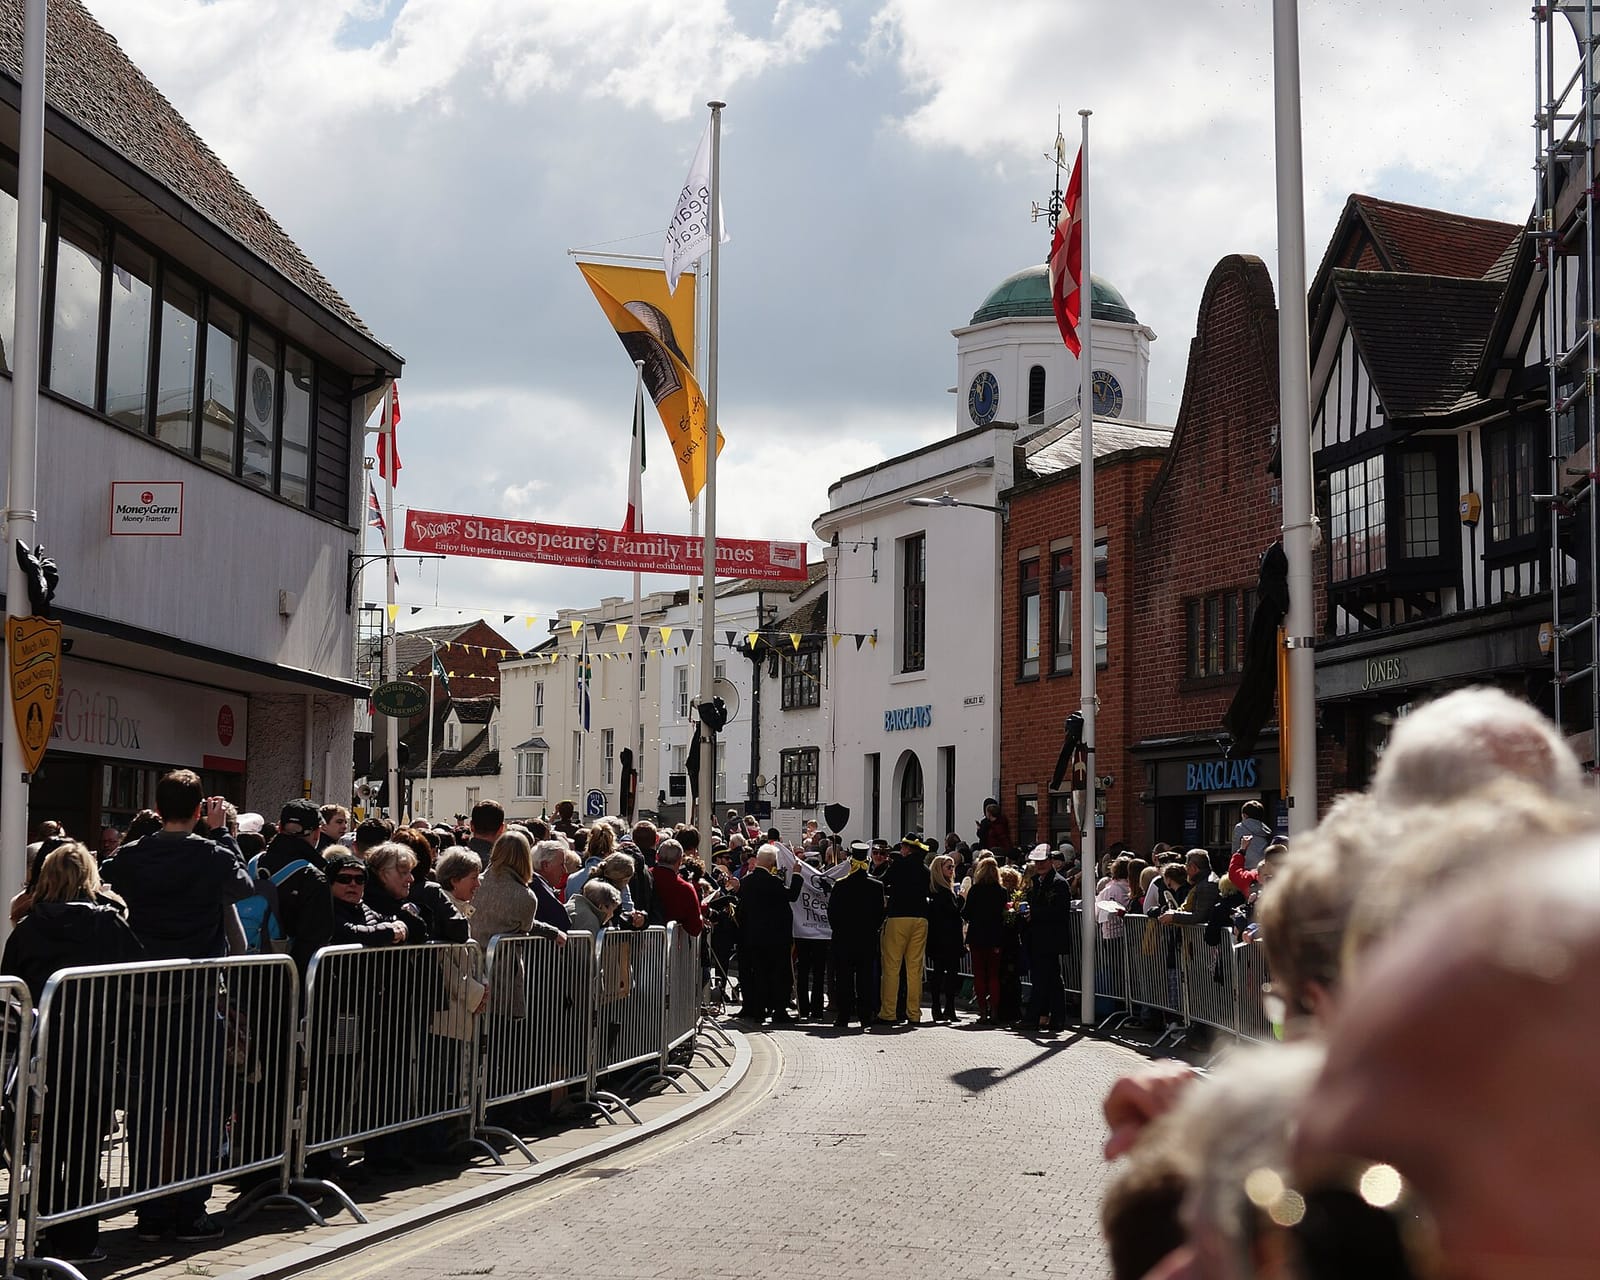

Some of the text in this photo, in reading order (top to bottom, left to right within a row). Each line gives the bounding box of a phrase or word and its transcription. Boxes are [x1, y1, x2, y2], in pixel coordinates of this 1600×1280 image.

[679, 440, 699, 465] 1564
[115, 504, 179, 516] MoneyGram
[121, 515, 144, 524] Money
[464, 520, 607, 552] Shakespeare's
[613, 536, 681, 562] Family
[686, 541, 754, 562] Hmes
[435, 541, 459, 552] Enjoy
[460, 543, 476, 553] live
[477, 546, 537, 559] performances,
[537, 552, 565, 563] family
[605, 558, 638, 568] festivals
[639, 561, 655, 569] and
[715, 566, 748, 575] oughout
[749, 567, 763, 575] the
[764, 569, 781, 577] year
[1361, 658, 1400, 691] JONES
[884, 704, 932, 732] BARCLAYS
[1186, 758, 1257, 791] BARCLAYS
